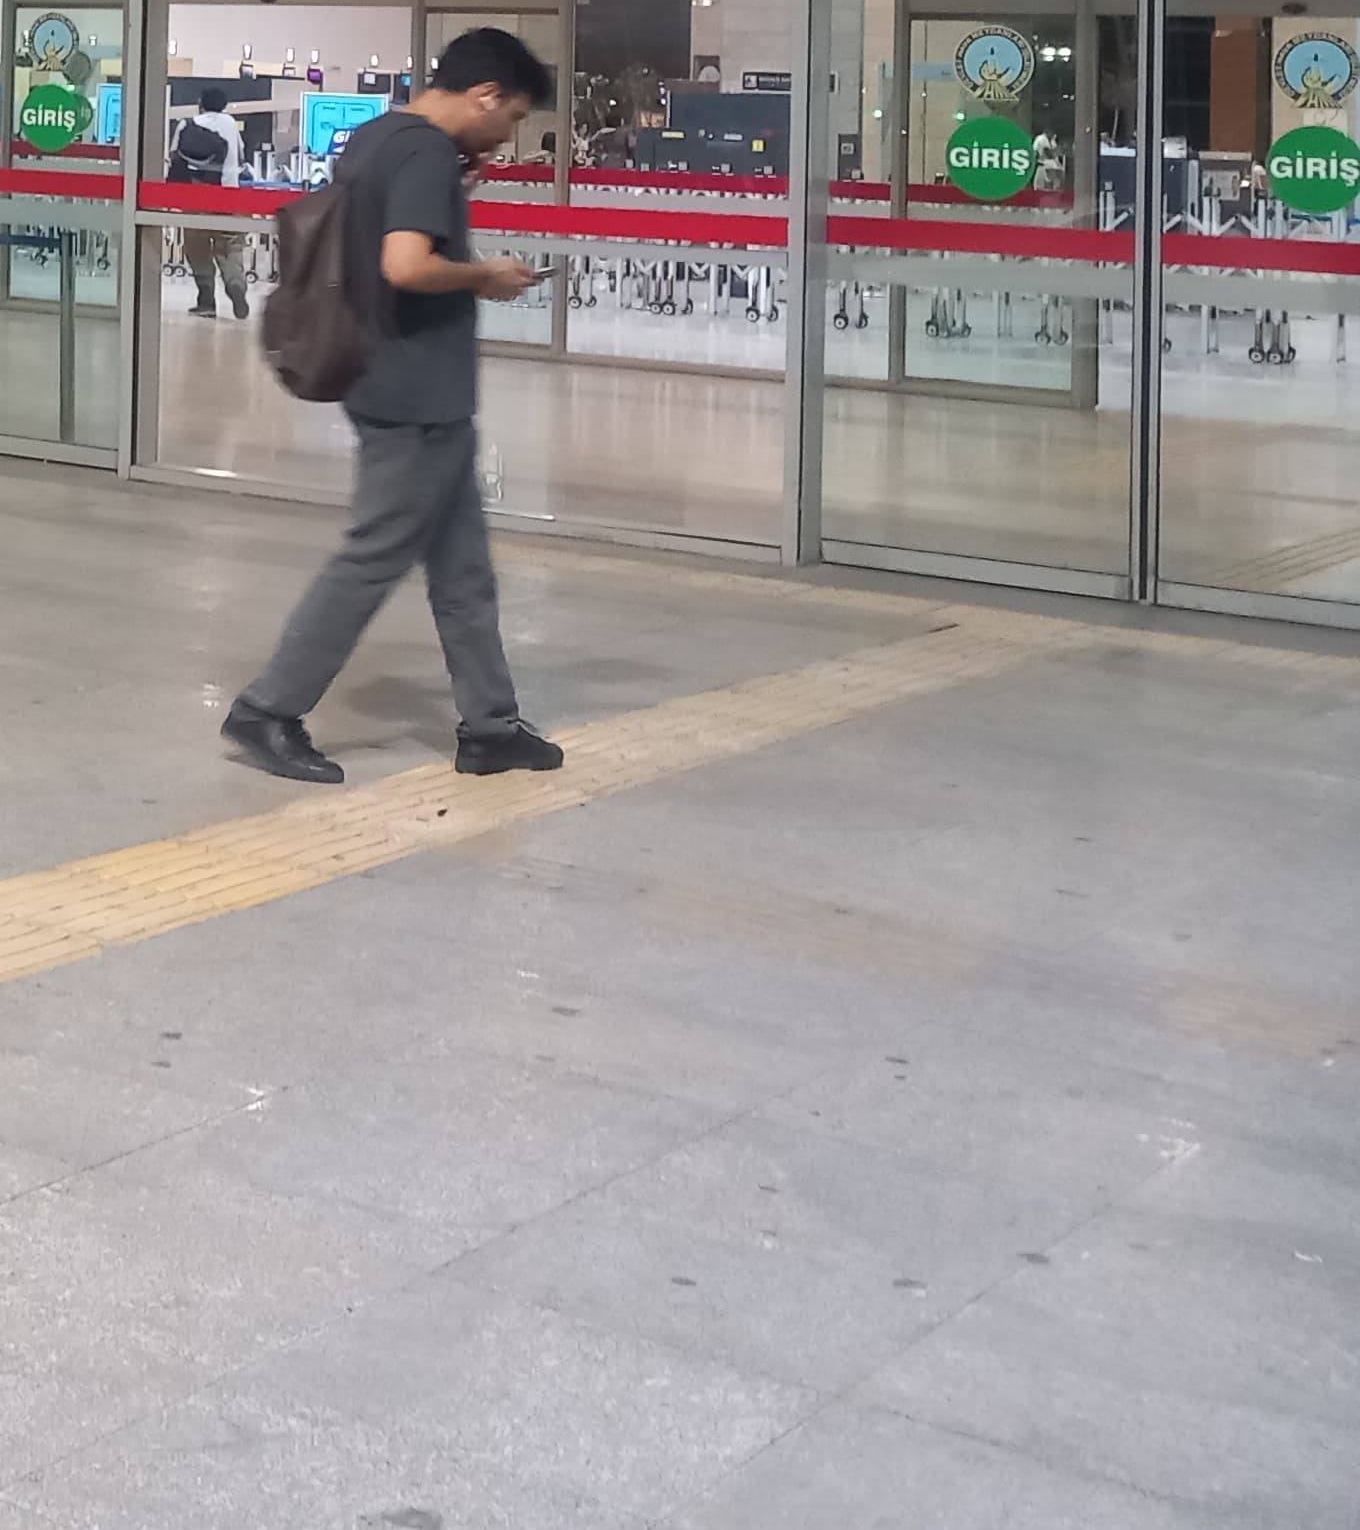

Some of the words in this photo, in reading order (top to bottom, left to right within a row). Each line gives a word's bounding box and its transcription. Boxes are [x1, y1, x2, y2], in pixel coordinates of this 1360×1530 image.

[23, 103, 76, 131] GİRİŞ
[949, 140, 1030, 176] GİRİŞ
[1270, 150, 1360, 187] GİRİŞ
